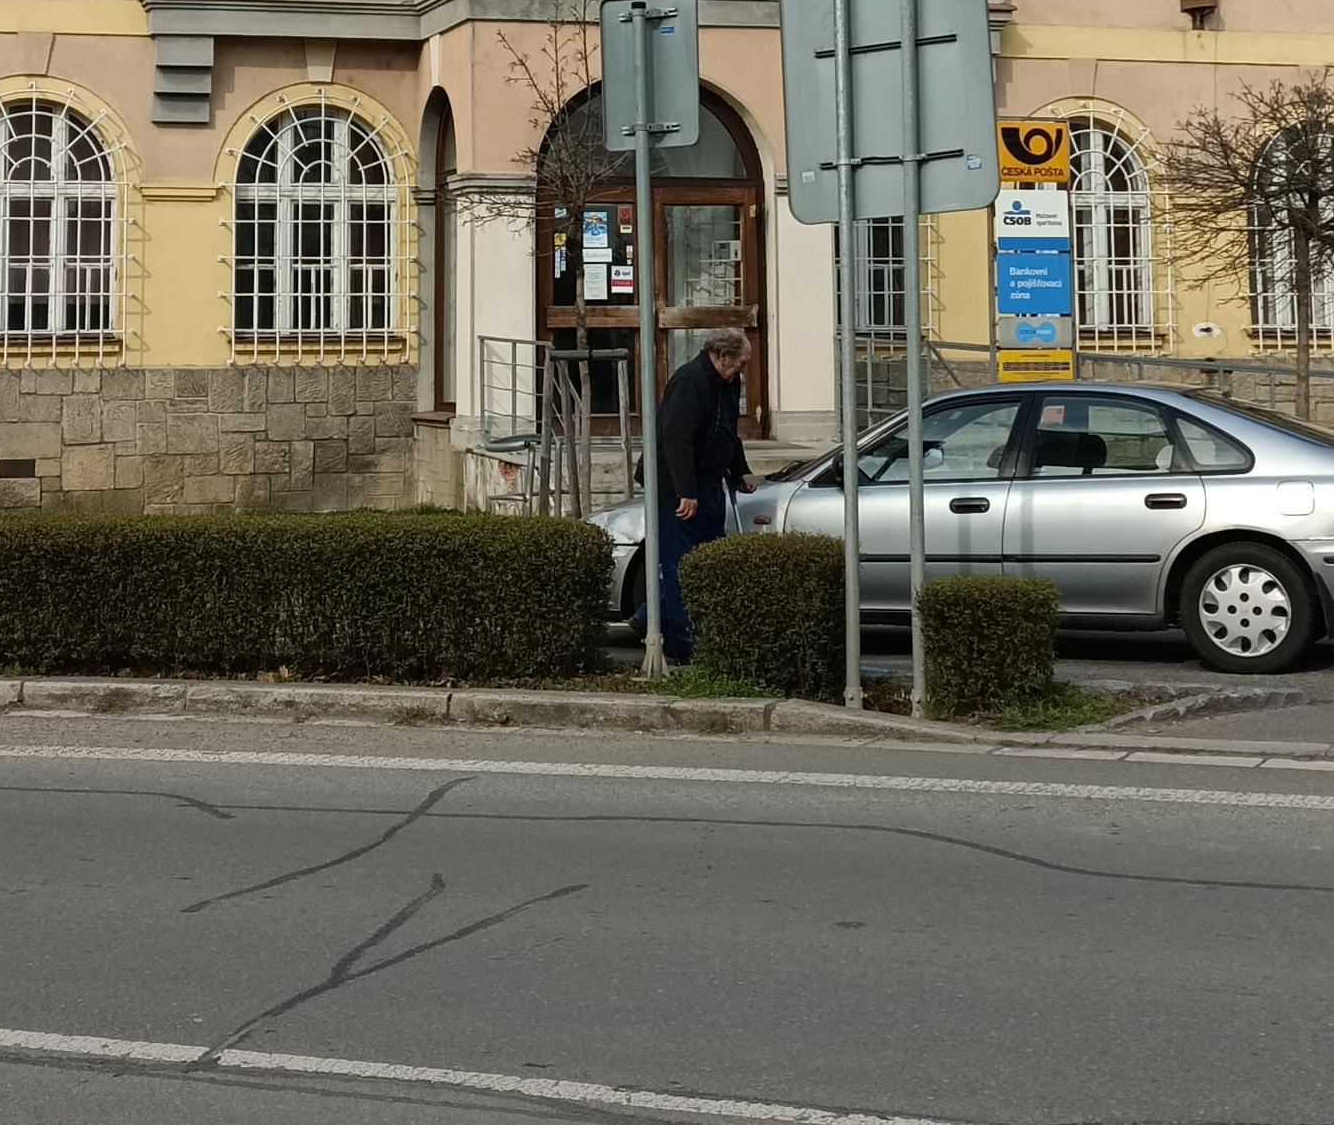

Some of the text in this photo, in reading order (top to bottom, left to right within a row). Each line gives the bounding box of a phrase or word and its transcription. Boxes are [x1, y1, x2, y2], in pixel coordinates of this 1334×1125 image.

[1001, 166, 1064, 177] ČESKÁ POŠTA
[1003, 215, 1032, 226] ČSOB
[1009, 266, 1048, 276] Bankovní
